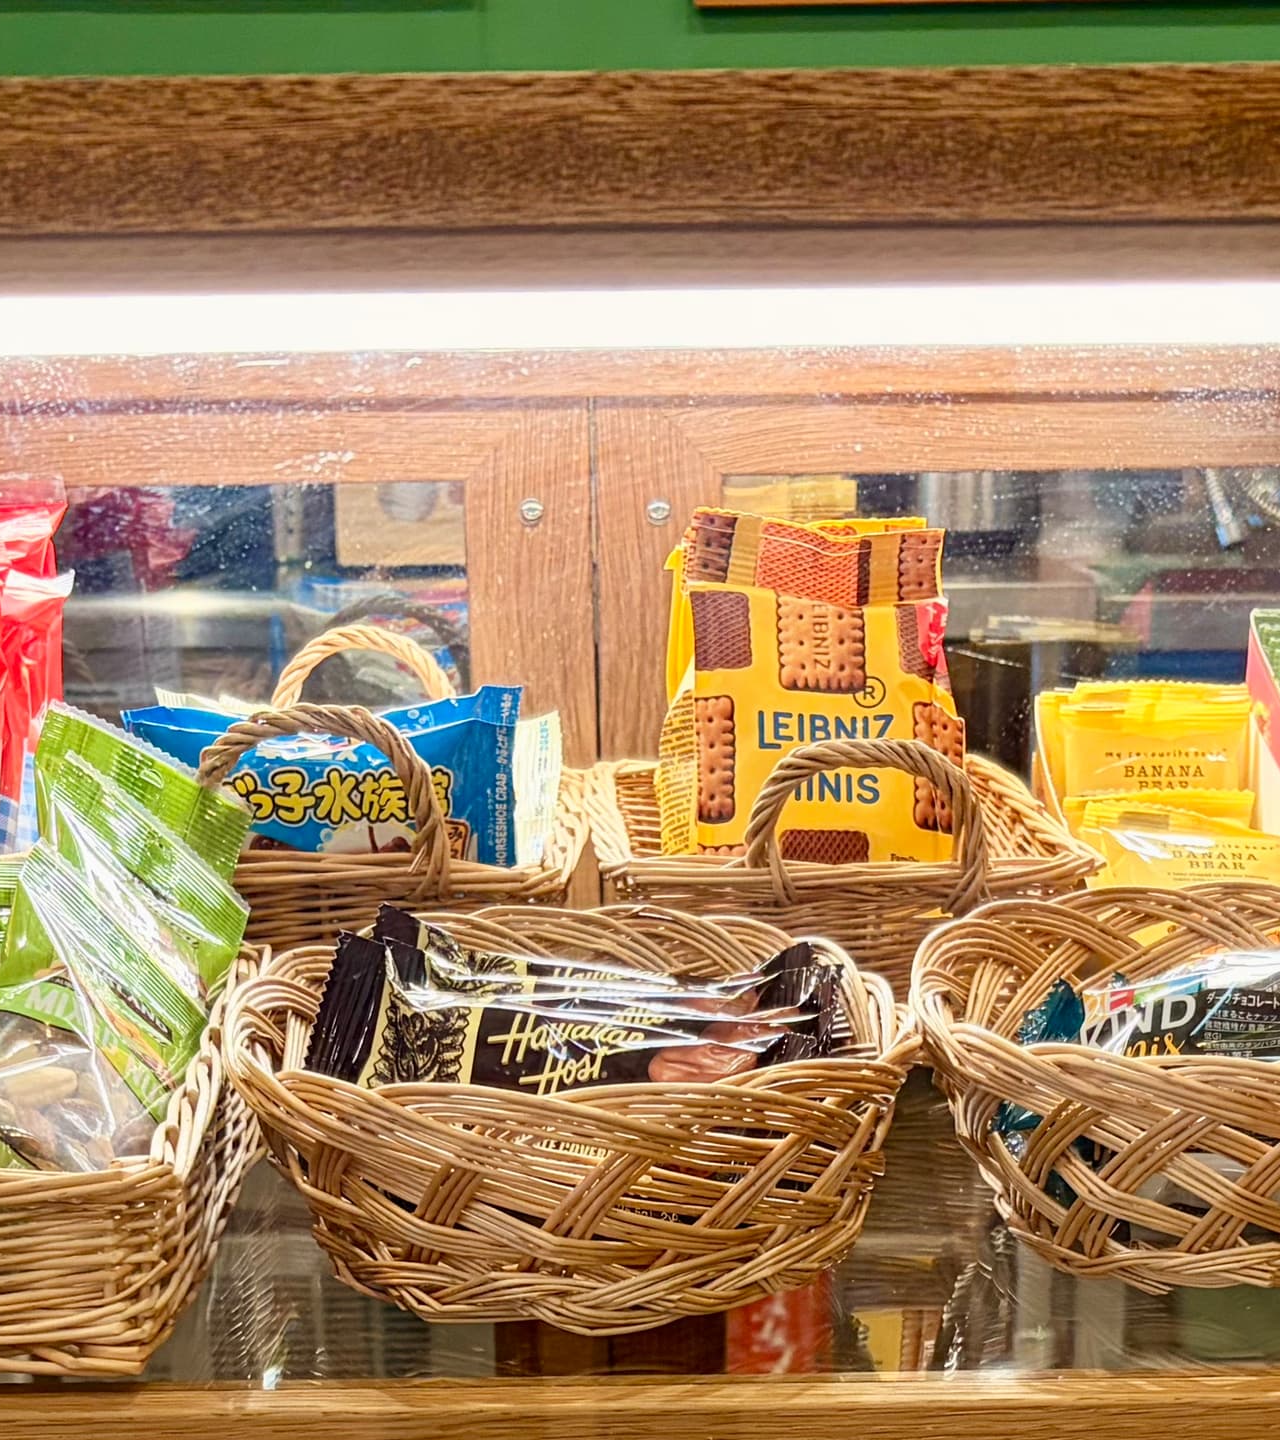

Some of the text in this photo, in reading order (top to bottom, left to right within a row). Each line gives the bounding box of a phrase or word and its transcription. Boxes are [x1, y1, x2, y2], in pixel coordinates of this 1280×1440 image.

[812, 604, 832, 672] EIBNIZ
[758, 710, 894, 750] LEIBNIZ
[1123, 765, 1205, 778] BANANA
[495, 804, 508, 867] HORSESHOE
[1171, 850, 1260, 861] BANANA
[1188, 860, 1247, 871] BEAR
[487, 1013, 645, 1065] Hawaiian
[519, 1047, 604, 1095] Host
